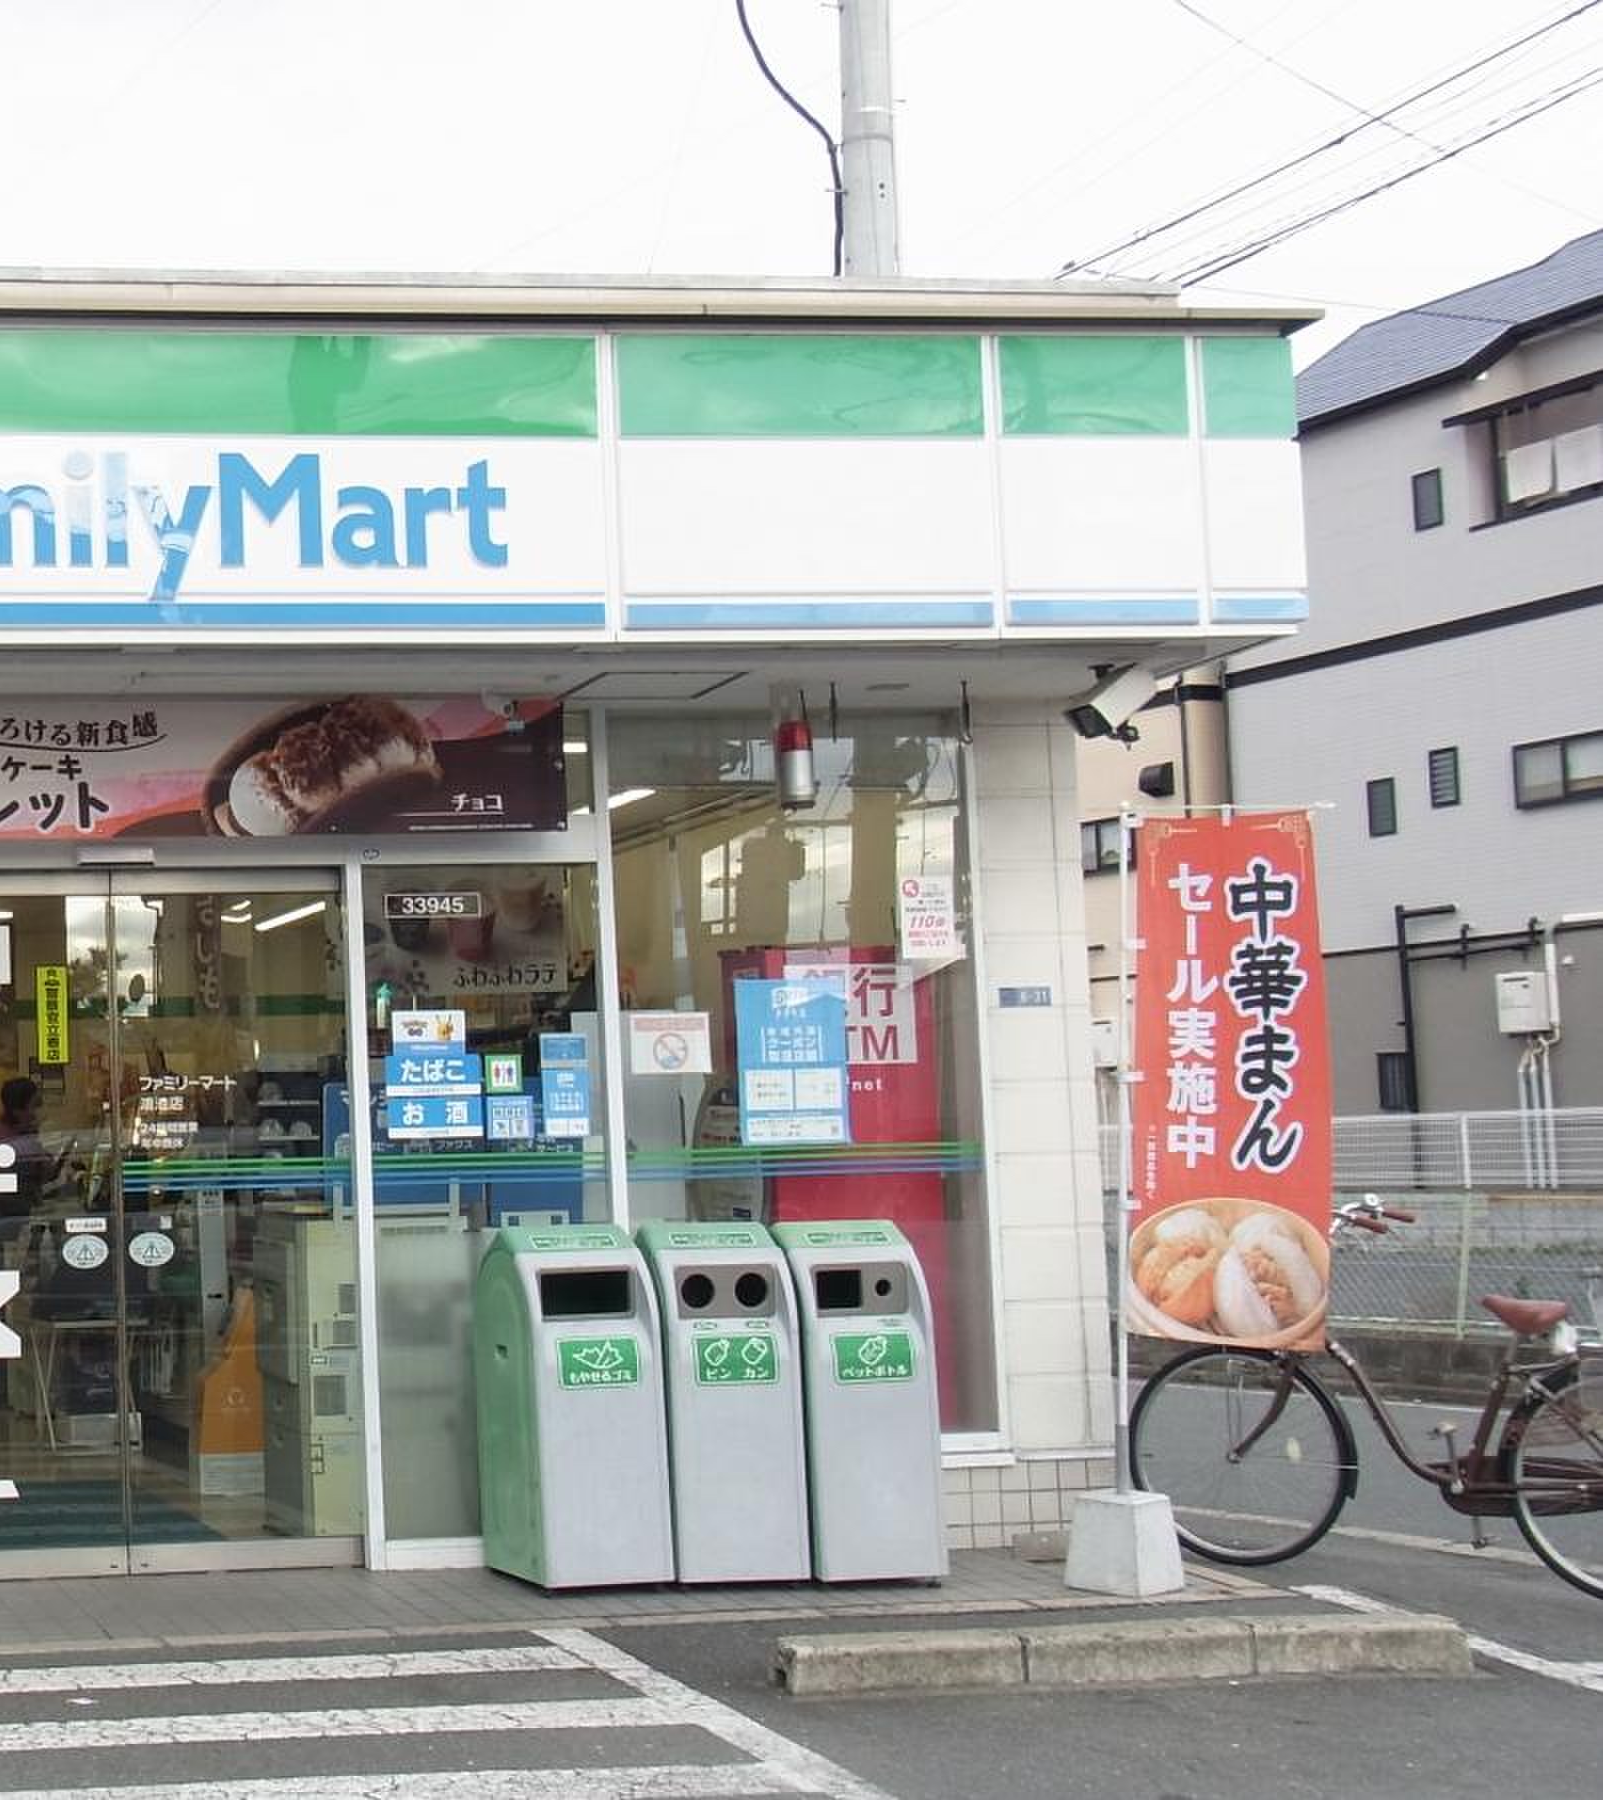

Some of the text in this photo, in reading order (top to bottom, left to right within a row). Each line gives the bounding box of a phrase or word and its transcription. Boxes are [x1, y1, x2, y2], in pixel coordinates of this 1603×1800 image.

[450, 793, 504, 811] チョコ
[401, 896, 464, 914] 33945
[452, 962, 558, 987] ふわふわラテ
[1166, 862, 1218, 1170] セール実施中
[1227, 860, 1305, 1169] 中華まん
[400, 1060, 466, 1082] たばこ
[139, 1075, 237, 1091] ファミリーマート
[569, 1370, 631, 1384] もやせるゴミ
[706, 1368, 732, 1378] ビン
[745, 1368, 769, 1378] カン
[842, 1366, 908, 1377] ペットボトル
